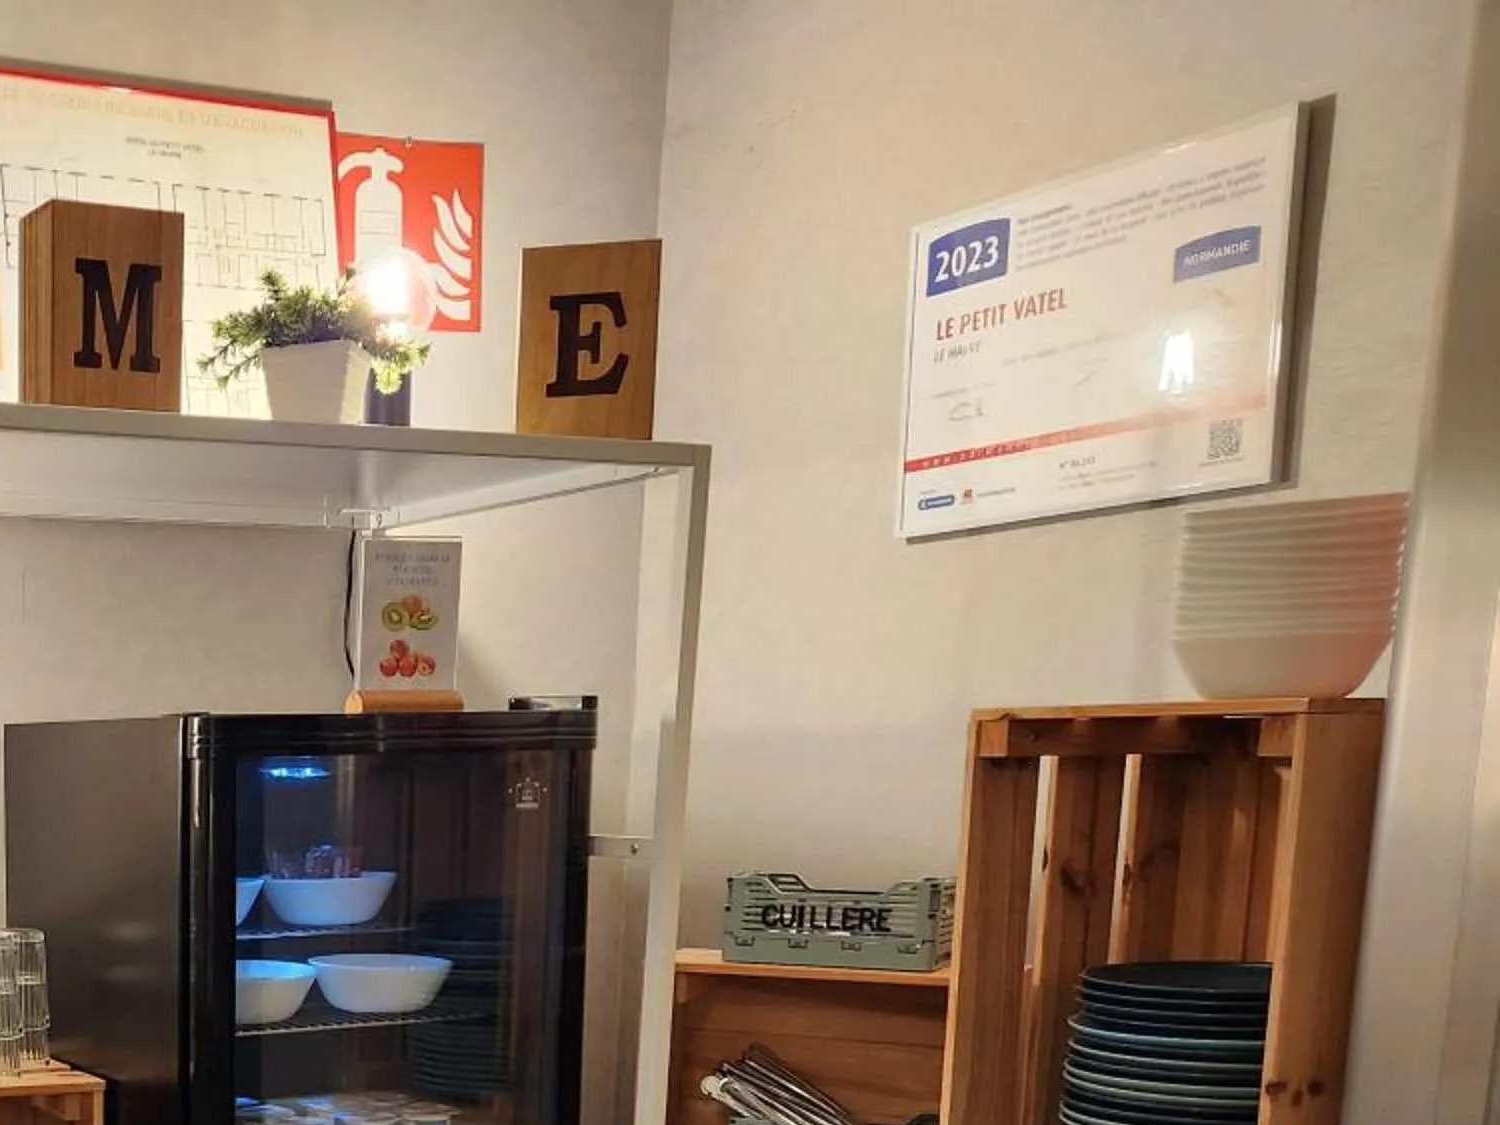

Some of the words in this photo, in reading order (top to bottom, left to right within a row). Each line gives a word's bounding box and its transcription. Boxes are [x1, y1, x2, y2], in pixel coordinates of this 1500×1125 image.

[934, 235, 999, 283] 2023
[1183, 239, 1251, 267] NORMANDIE
[73, 257, 162, 373] M
[546, 291, 630, 399] E
[936, 317, 955, 341] LE
[959, 303, 1008, 335] PETIT
[1013, 287, 1068, 321] VATEL
[761, 903, 893, 933] CUILLERE
